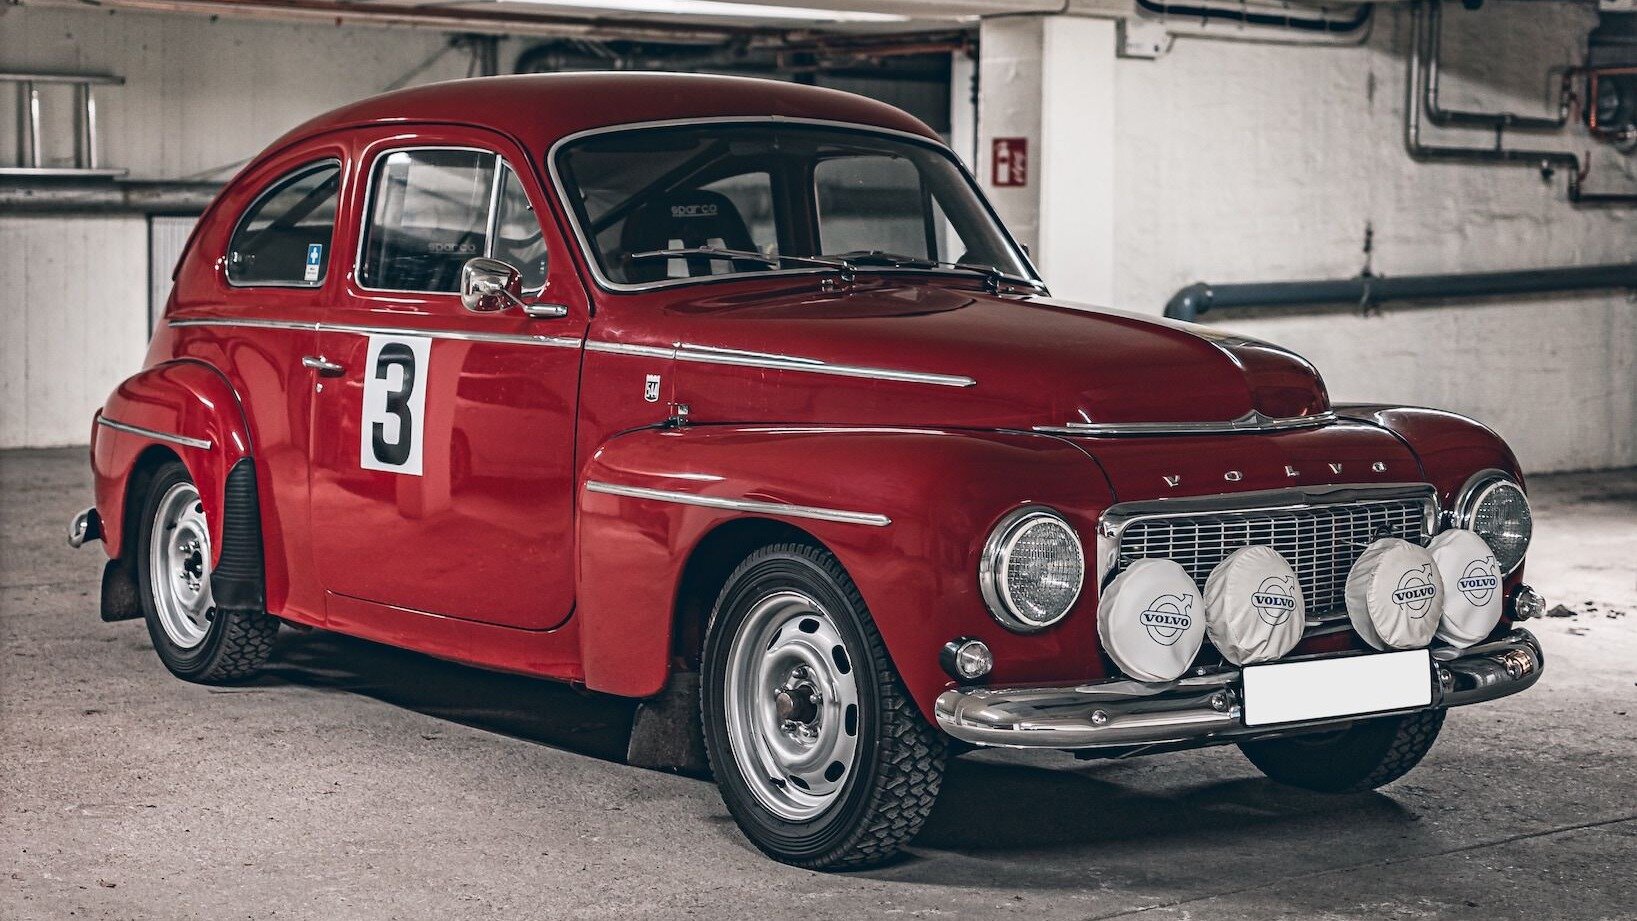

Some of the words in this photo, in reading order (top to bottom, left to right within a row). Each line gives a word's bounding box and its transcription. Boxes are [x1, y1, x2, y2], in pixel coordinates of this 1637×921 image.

[372, 342, 415, 465] 3
[1162, 461, 1387, 487] VOLVO
[1459, 578, 1497, 588] VOLVO
[1255, 595, 1295, 607] VOLVO
[1394, 587, 1435, 601] VOLVO
[1143, 613, 1190, 627] VOLVO
